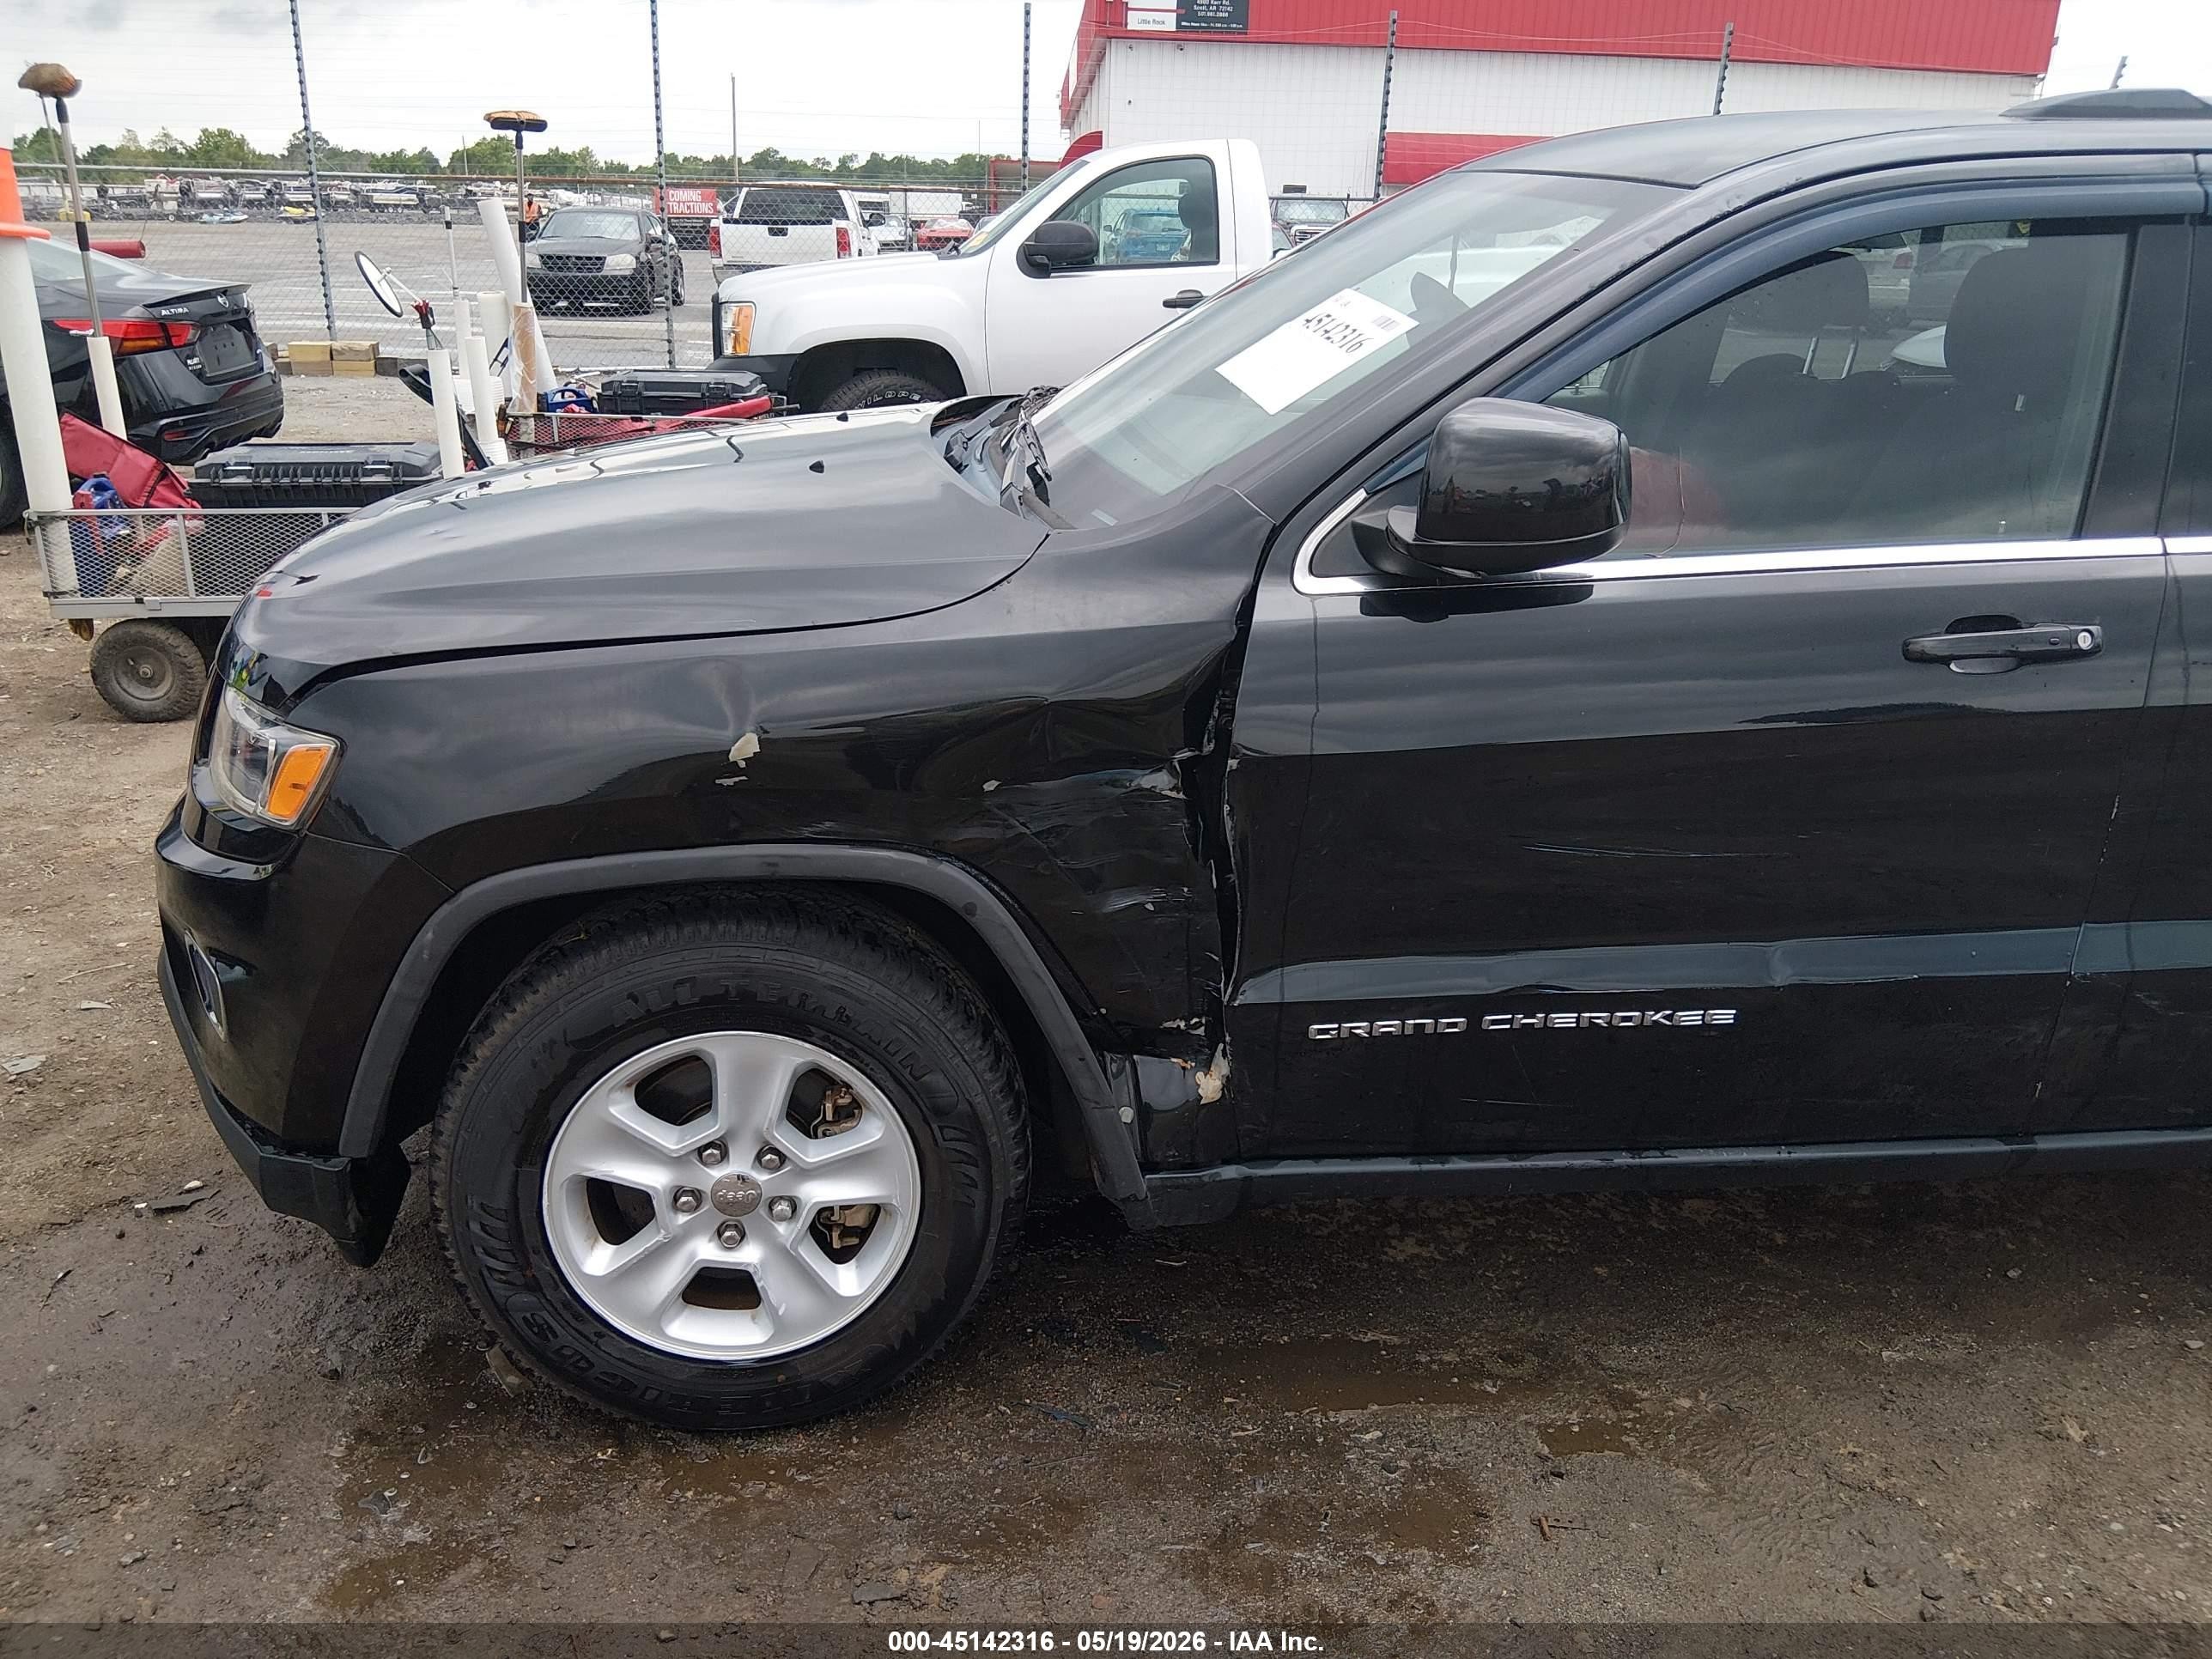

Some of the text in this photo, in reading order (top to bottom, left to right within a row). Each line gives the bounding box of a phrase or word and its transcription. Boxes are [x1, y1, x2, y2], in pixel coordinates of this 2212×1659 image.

[669, 190, 702, 202] COMING
[161, 307, 189, 316] ALTIMA
[1302, 312, 1375, 355] 45142316
[1308, 1009, 1736, 1040] GRAND CHEROKEE
